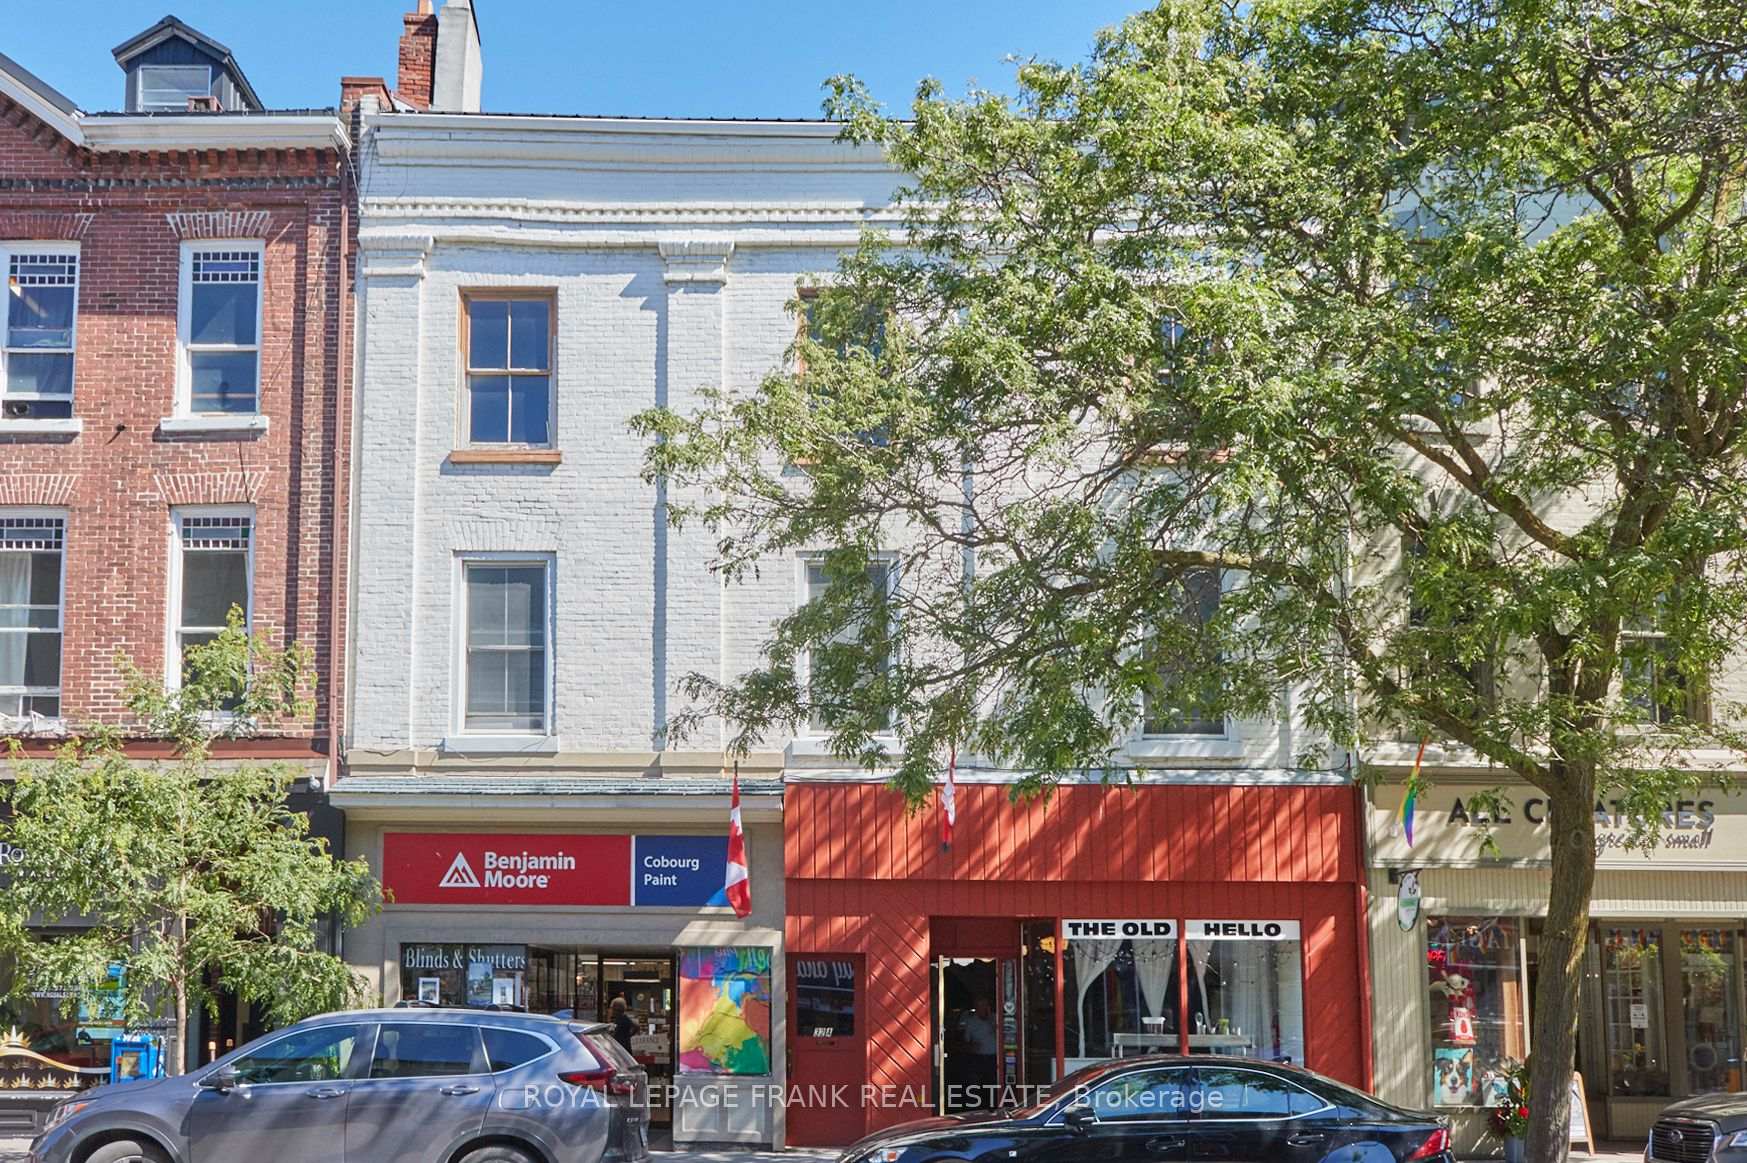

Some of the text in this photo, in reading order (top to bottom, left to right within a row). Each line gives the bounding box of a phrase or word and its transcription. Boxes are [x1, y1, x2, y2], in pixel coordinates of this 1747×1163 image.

[1665, 828, 1713, 849] small
[484, 851, 576, 871] Benjamin
[643, 855, 700, 871] Cobourg
[484, 870, 549, 889] Moore
[643, 873, 678, 887] Paint
[1068, 922, 1171, 936] THE OLD
[1204, 923, 1282, 937] HELLO
[405, 947, 526, 969] Blinds & Shutters
